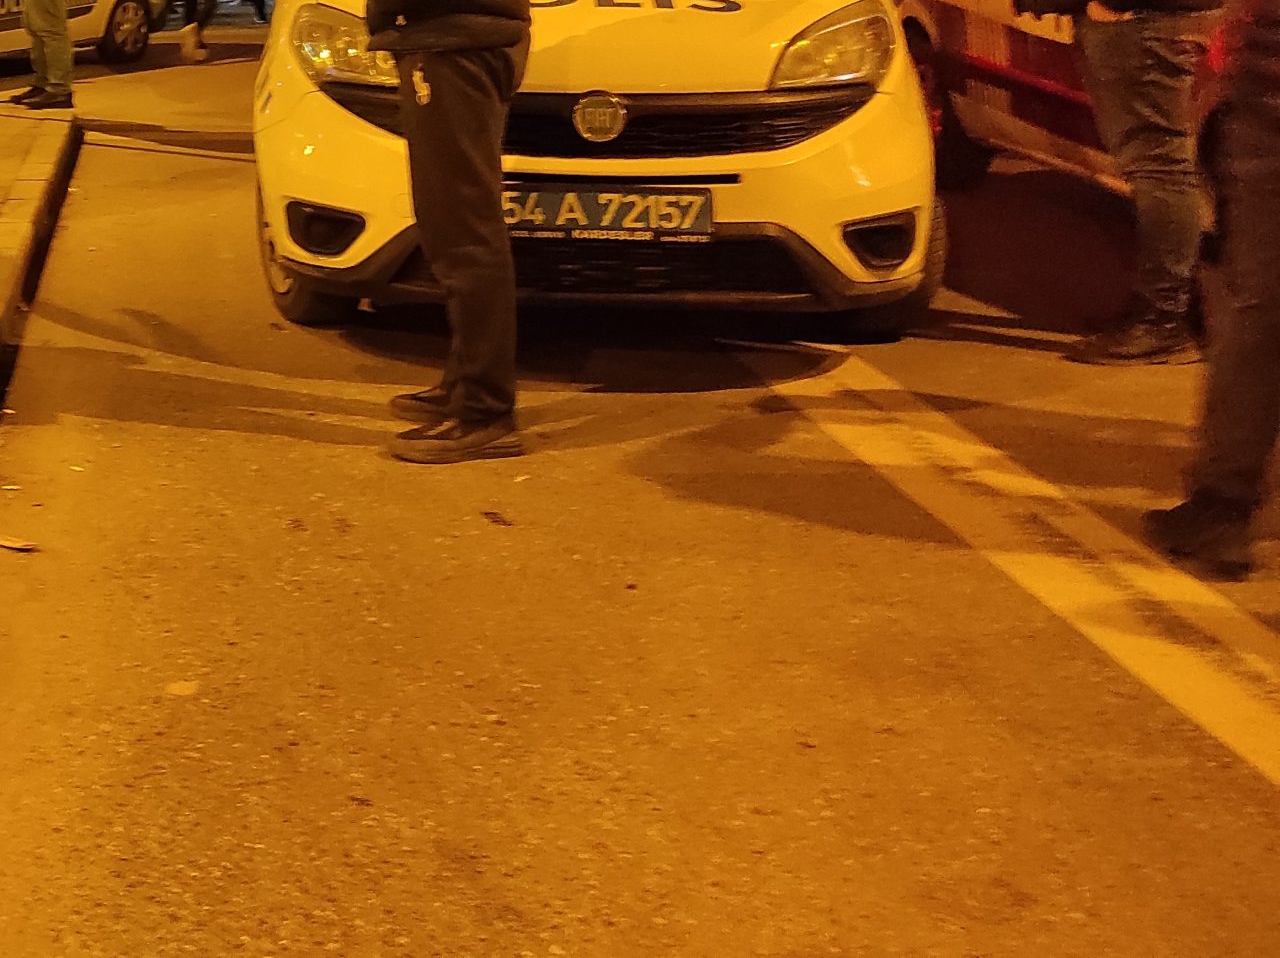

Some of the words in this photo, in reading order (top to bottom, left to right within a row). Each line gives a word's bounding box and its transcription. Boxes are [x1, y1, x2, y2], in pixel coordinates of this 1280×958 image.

[501, 191, 547, 225] 54
[555, 192, 589, 226] A
[597, 193, 706, 229] 72157
